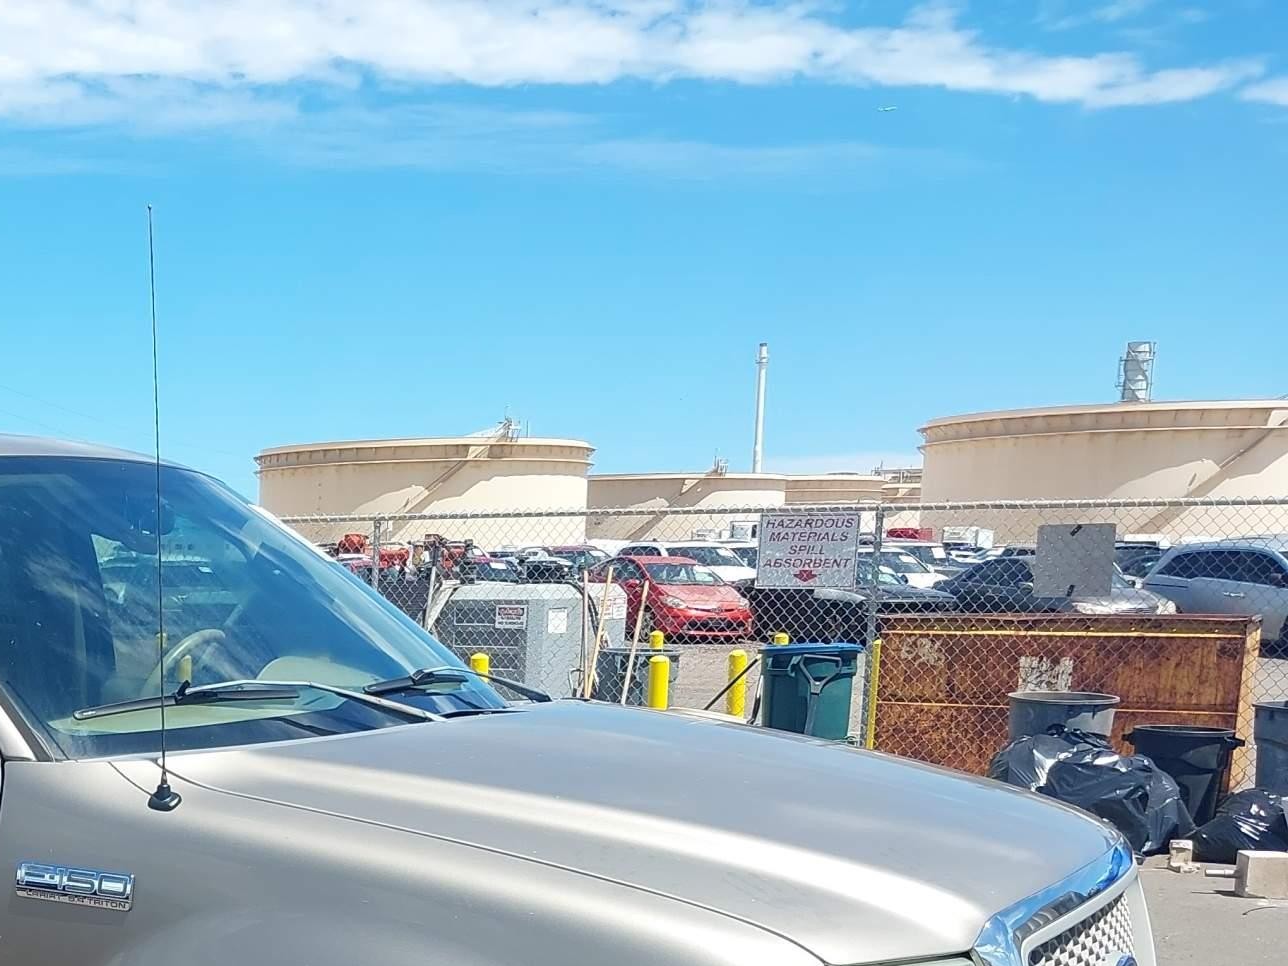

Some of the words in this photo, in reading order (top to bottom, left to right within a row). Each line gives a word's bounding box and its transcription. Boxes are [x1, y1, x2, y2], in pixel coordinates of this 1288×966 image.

[765, 518, 855, 529] HAZARDOUS
[768, 531, 849, 542] MATERIALS
[788, 544, 825, 555] SPILL
[763, 558, 852, 568] ABSORBENT
[18, 863, 130, 898] F-150
[85, 896, 127, 910] TRITON
